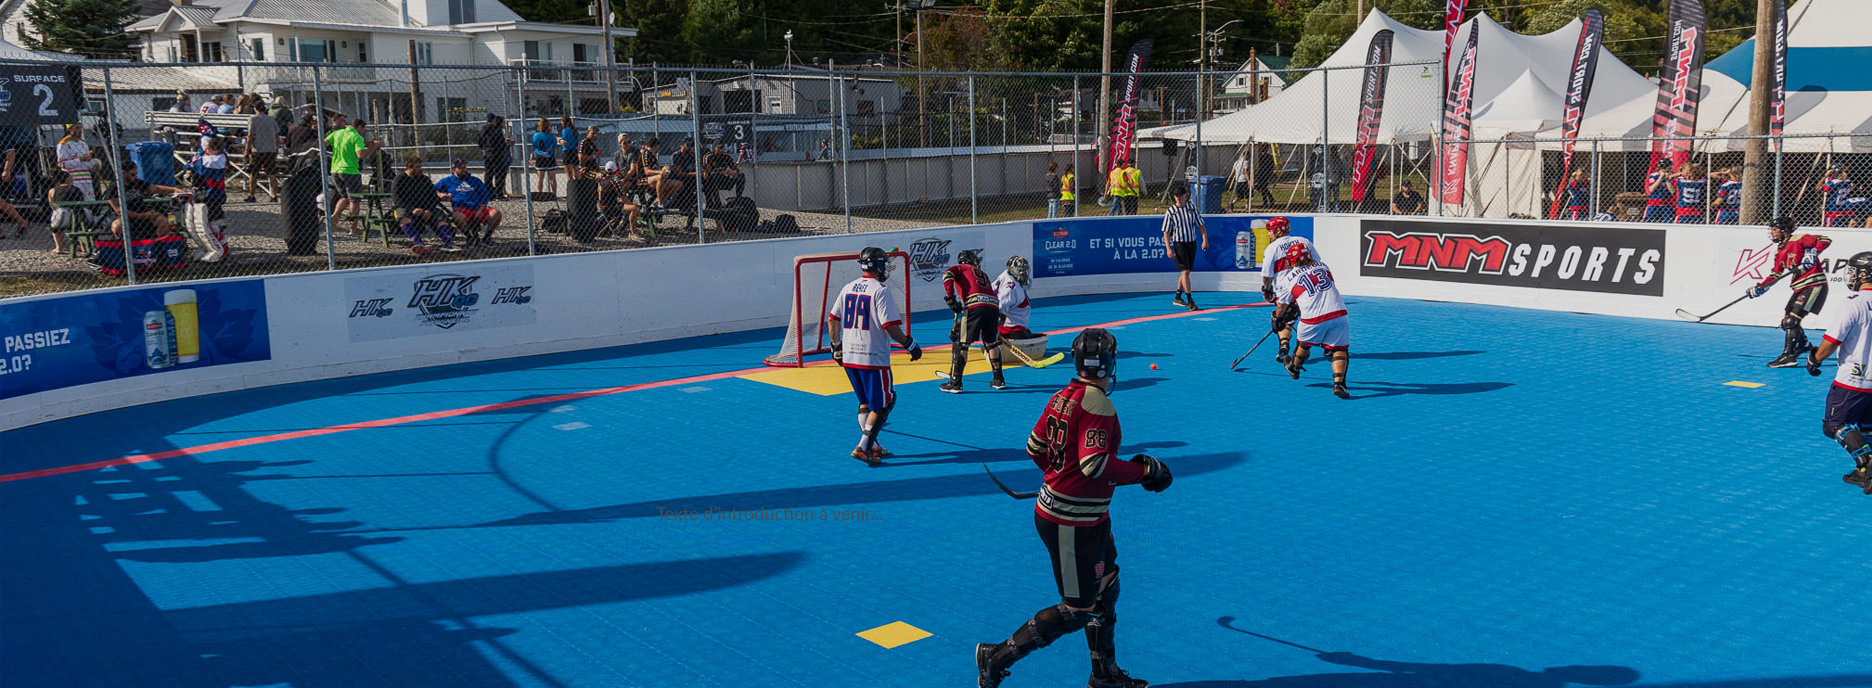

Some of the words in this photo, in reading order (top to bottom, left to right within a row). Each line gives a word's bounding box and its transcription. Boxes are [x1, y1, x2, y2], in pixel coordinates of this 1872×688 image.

[13, 74, 66, 83] SURFACE
[1124, 53, 1140, 103] SPORTCOM
[33, 83, 59, 117] 2
[734, 124, 744, 140] 3
[1352, 104, 1377, 184] MNM
[1045, 240, 1065, 251] CLEAR
[1065, 239, 1077, 249] 2.0
[1089, 238, 1101, 249] ET
[1104, 238, 1114, 249] SI
[1118, 237, 1145, 248] VOUS
[1113, 248, 1121, 259] À
[1124, 249, 1138, 259] LA
[1141, 248, 1165, 259] 2.0?
[1364, 230, 1512, 275] MNM
[1508, 243, 1661, 285] SPORTS
[1296, 268, 1333, 298] 13
[5, 328, 71, 353] PASSIEZ
[0, 354, 32, 376] 2.0?
[1085, 428, 1107, 449] 88
